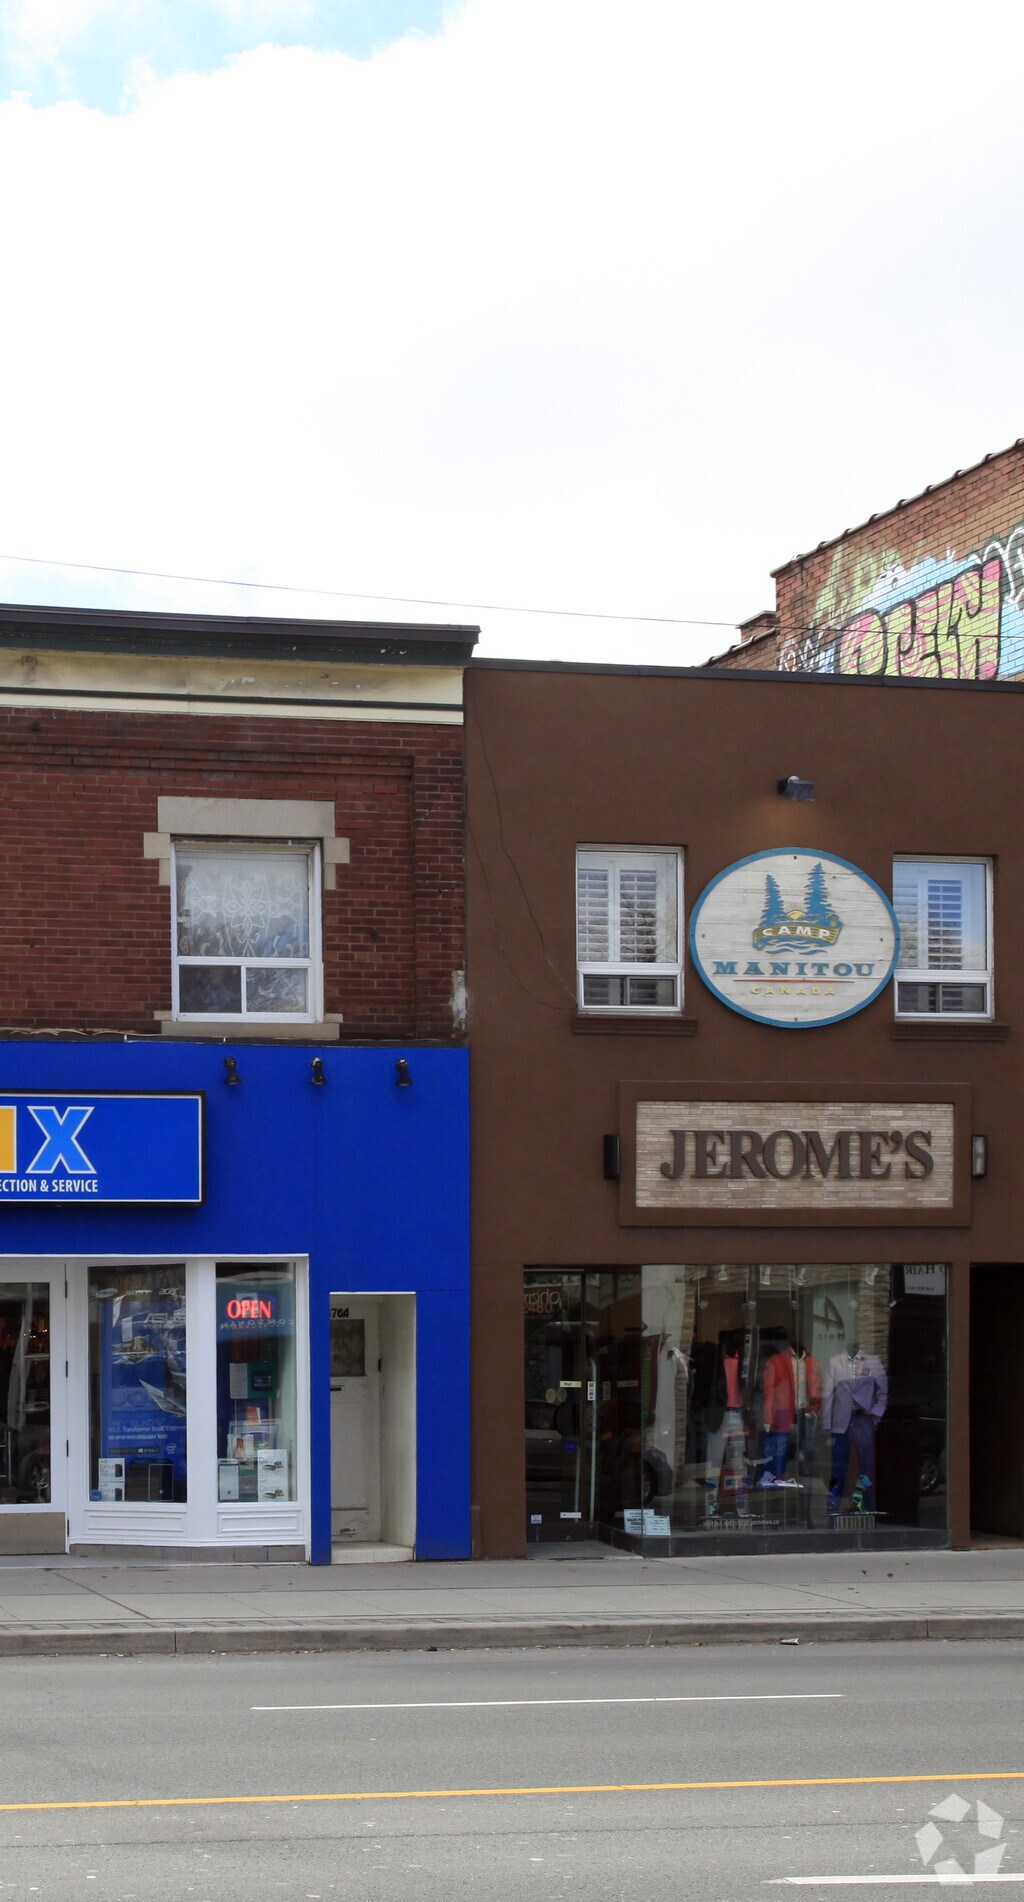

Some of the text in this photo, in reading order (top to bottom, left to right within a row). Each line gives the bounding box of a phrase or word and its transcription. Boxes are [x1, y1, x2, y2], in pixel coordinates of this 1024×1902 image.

[762, 925, 831, 940] CAMP
[711, 960, 875, 977] MANITOU
[751, 986, 836, 997] CANADA
[660, 1129, 934, 1180] JEROME'S
[40, 1180, 49, 1192] &
[52, 1179, 98, 1193] SERVICE
[226, 1299, 273, 1319] OPEN
[329, 1307, 350, 1318] 70A
